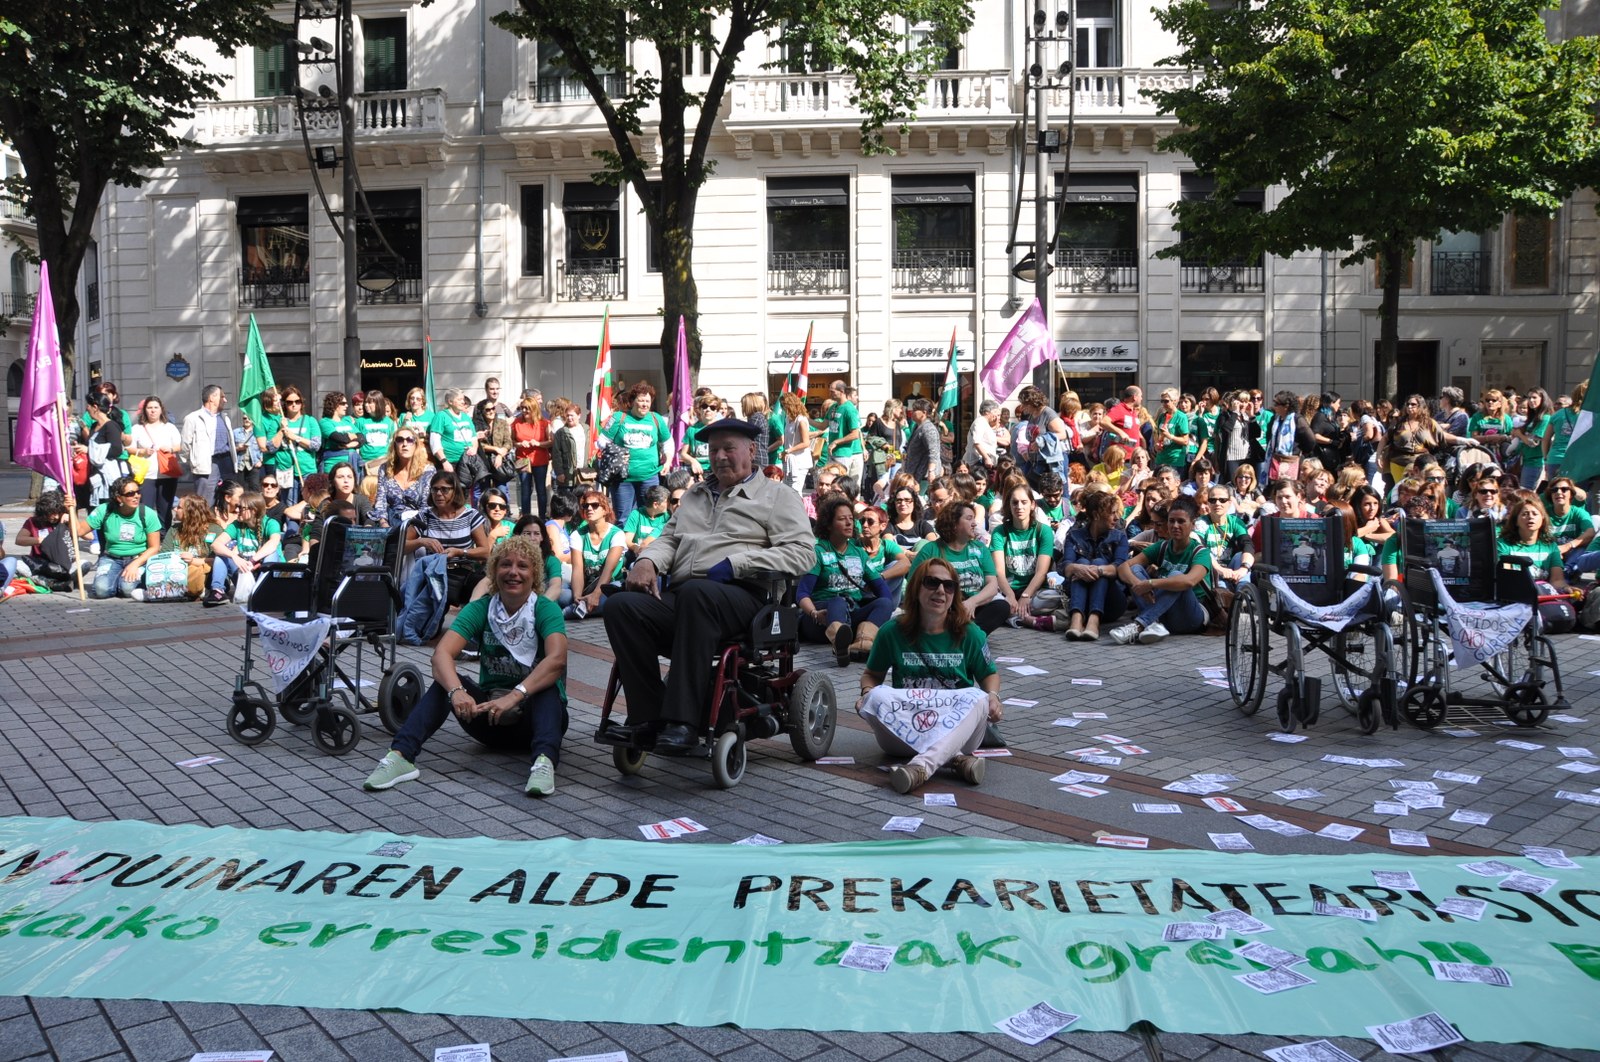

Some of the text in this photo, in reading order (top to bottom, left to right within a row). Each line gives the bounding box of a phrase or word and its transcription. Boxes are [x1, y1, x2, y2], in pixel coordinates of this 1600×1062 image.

[774, 348, 818, 359] LACOE
[899, 347, 944, 358] LACOSTE
[1063, 346, 1107, 356] LACOSTE
[394, 357, 417, 368] Dutti
[891, 694, 960, 713] DESPIDOS
[470, 867, 680, 910] ALDE
[258, 920, 1022, 969] erresidentzak
